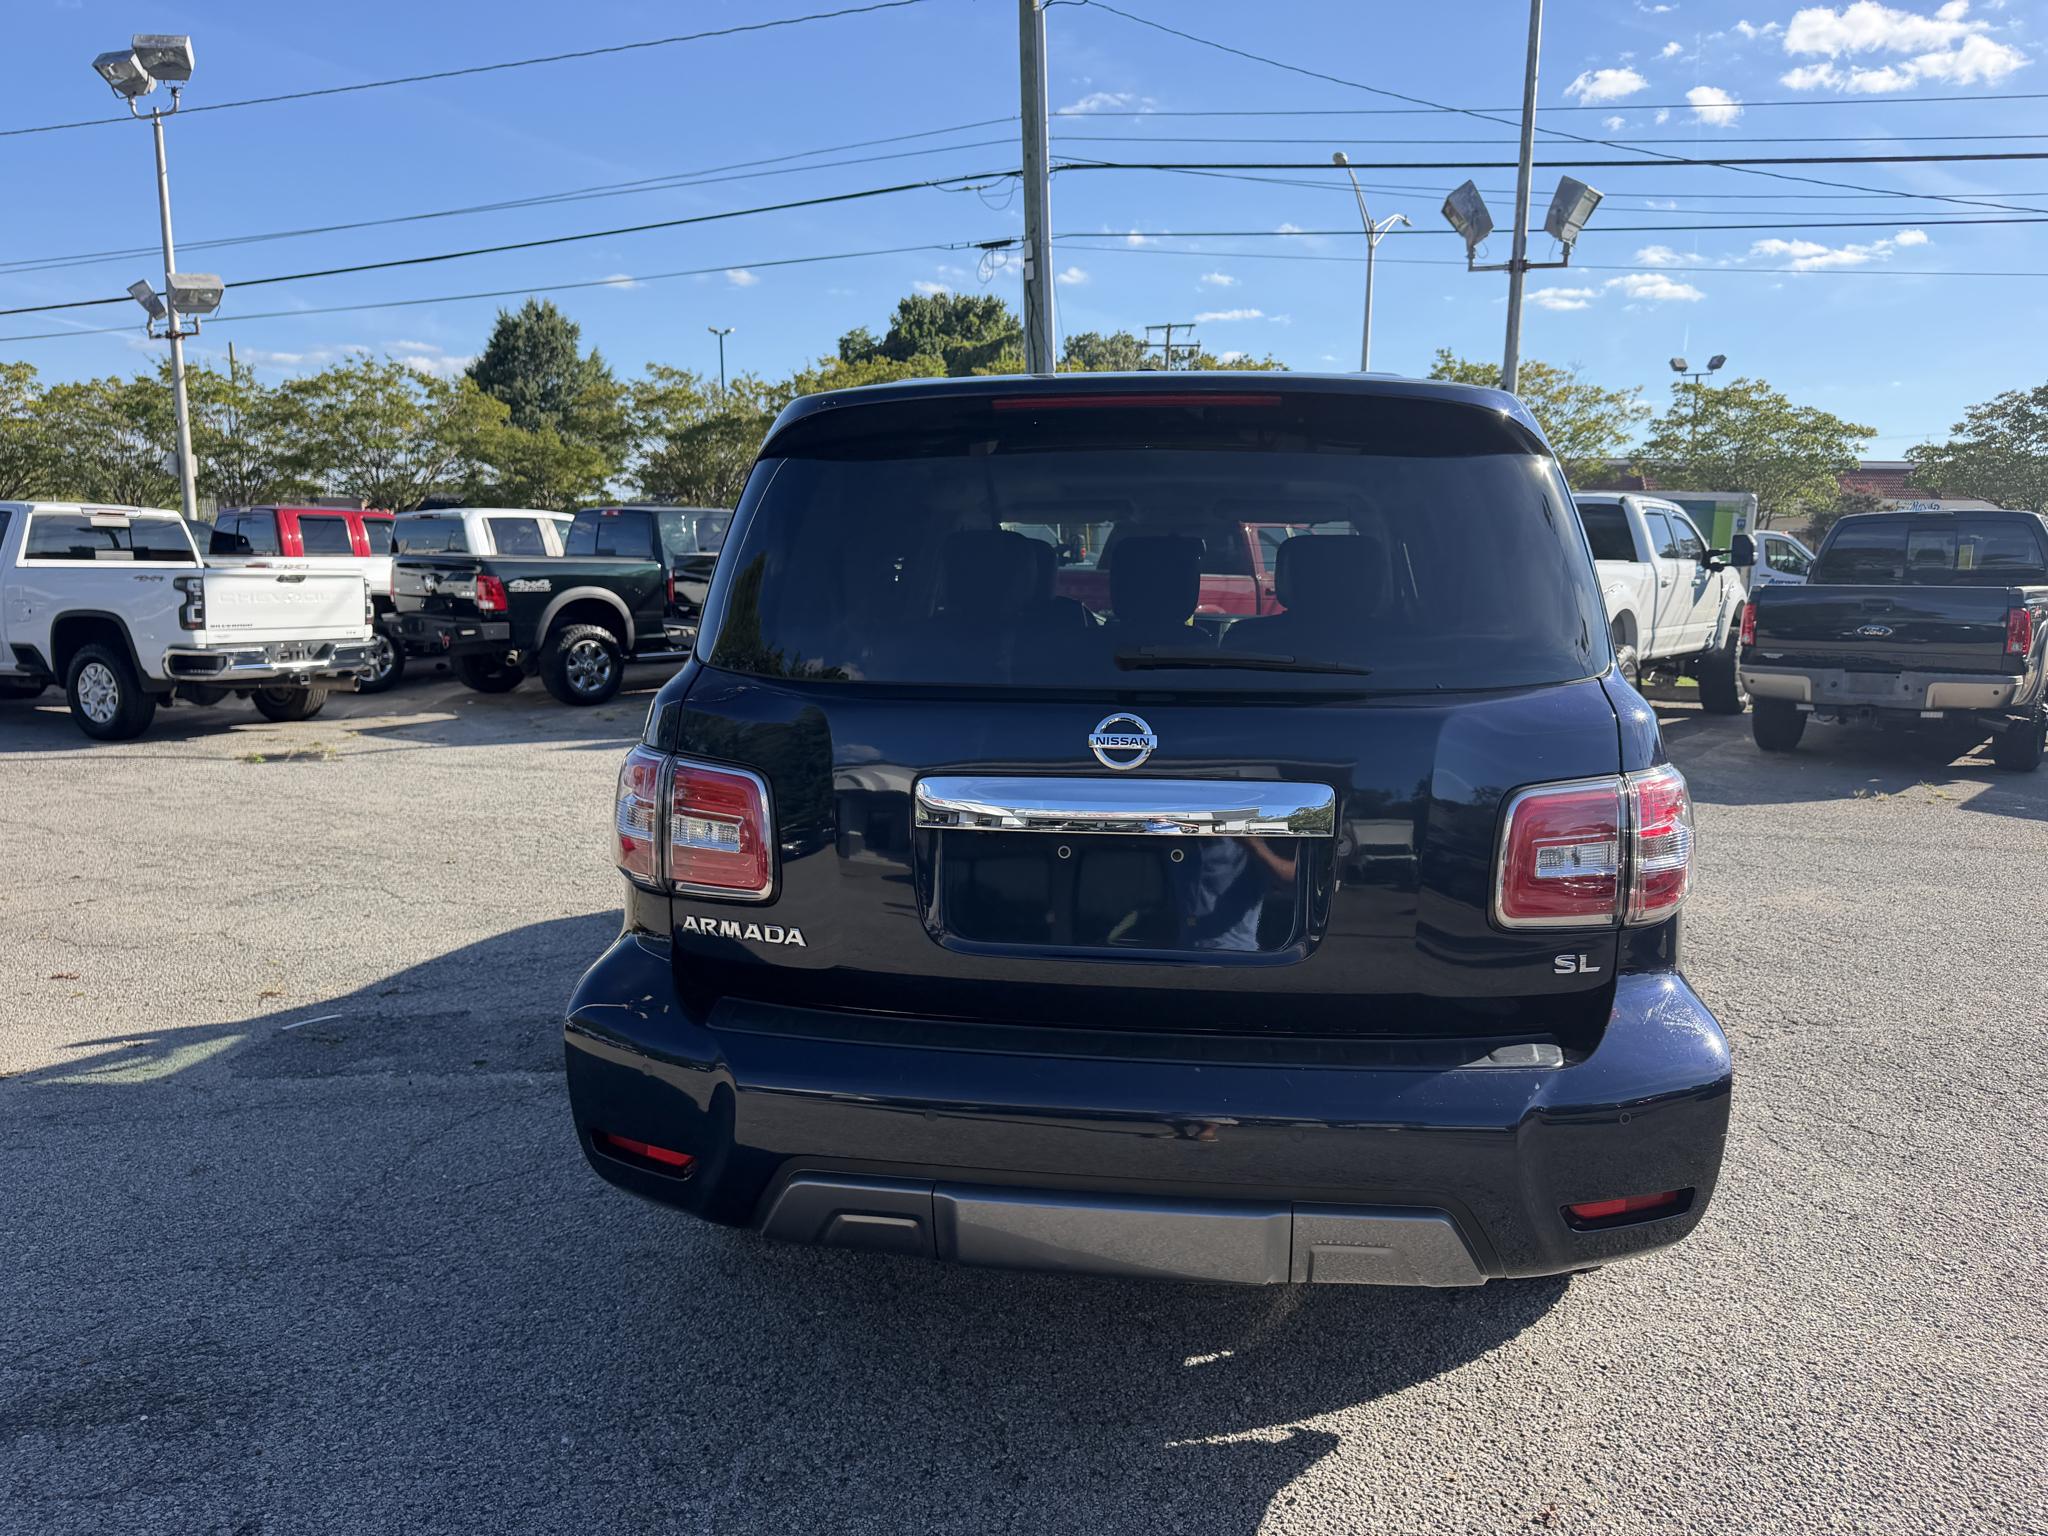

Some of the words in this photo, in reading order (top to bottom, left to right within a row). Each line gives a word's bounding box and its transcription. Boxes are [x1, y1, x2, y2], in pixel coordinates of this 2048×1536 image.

[1096, 736, 1150, 746] NISSAN
[682, 915, 806, 947] ARMADA
[1553, 954, 1601, 974] SL
